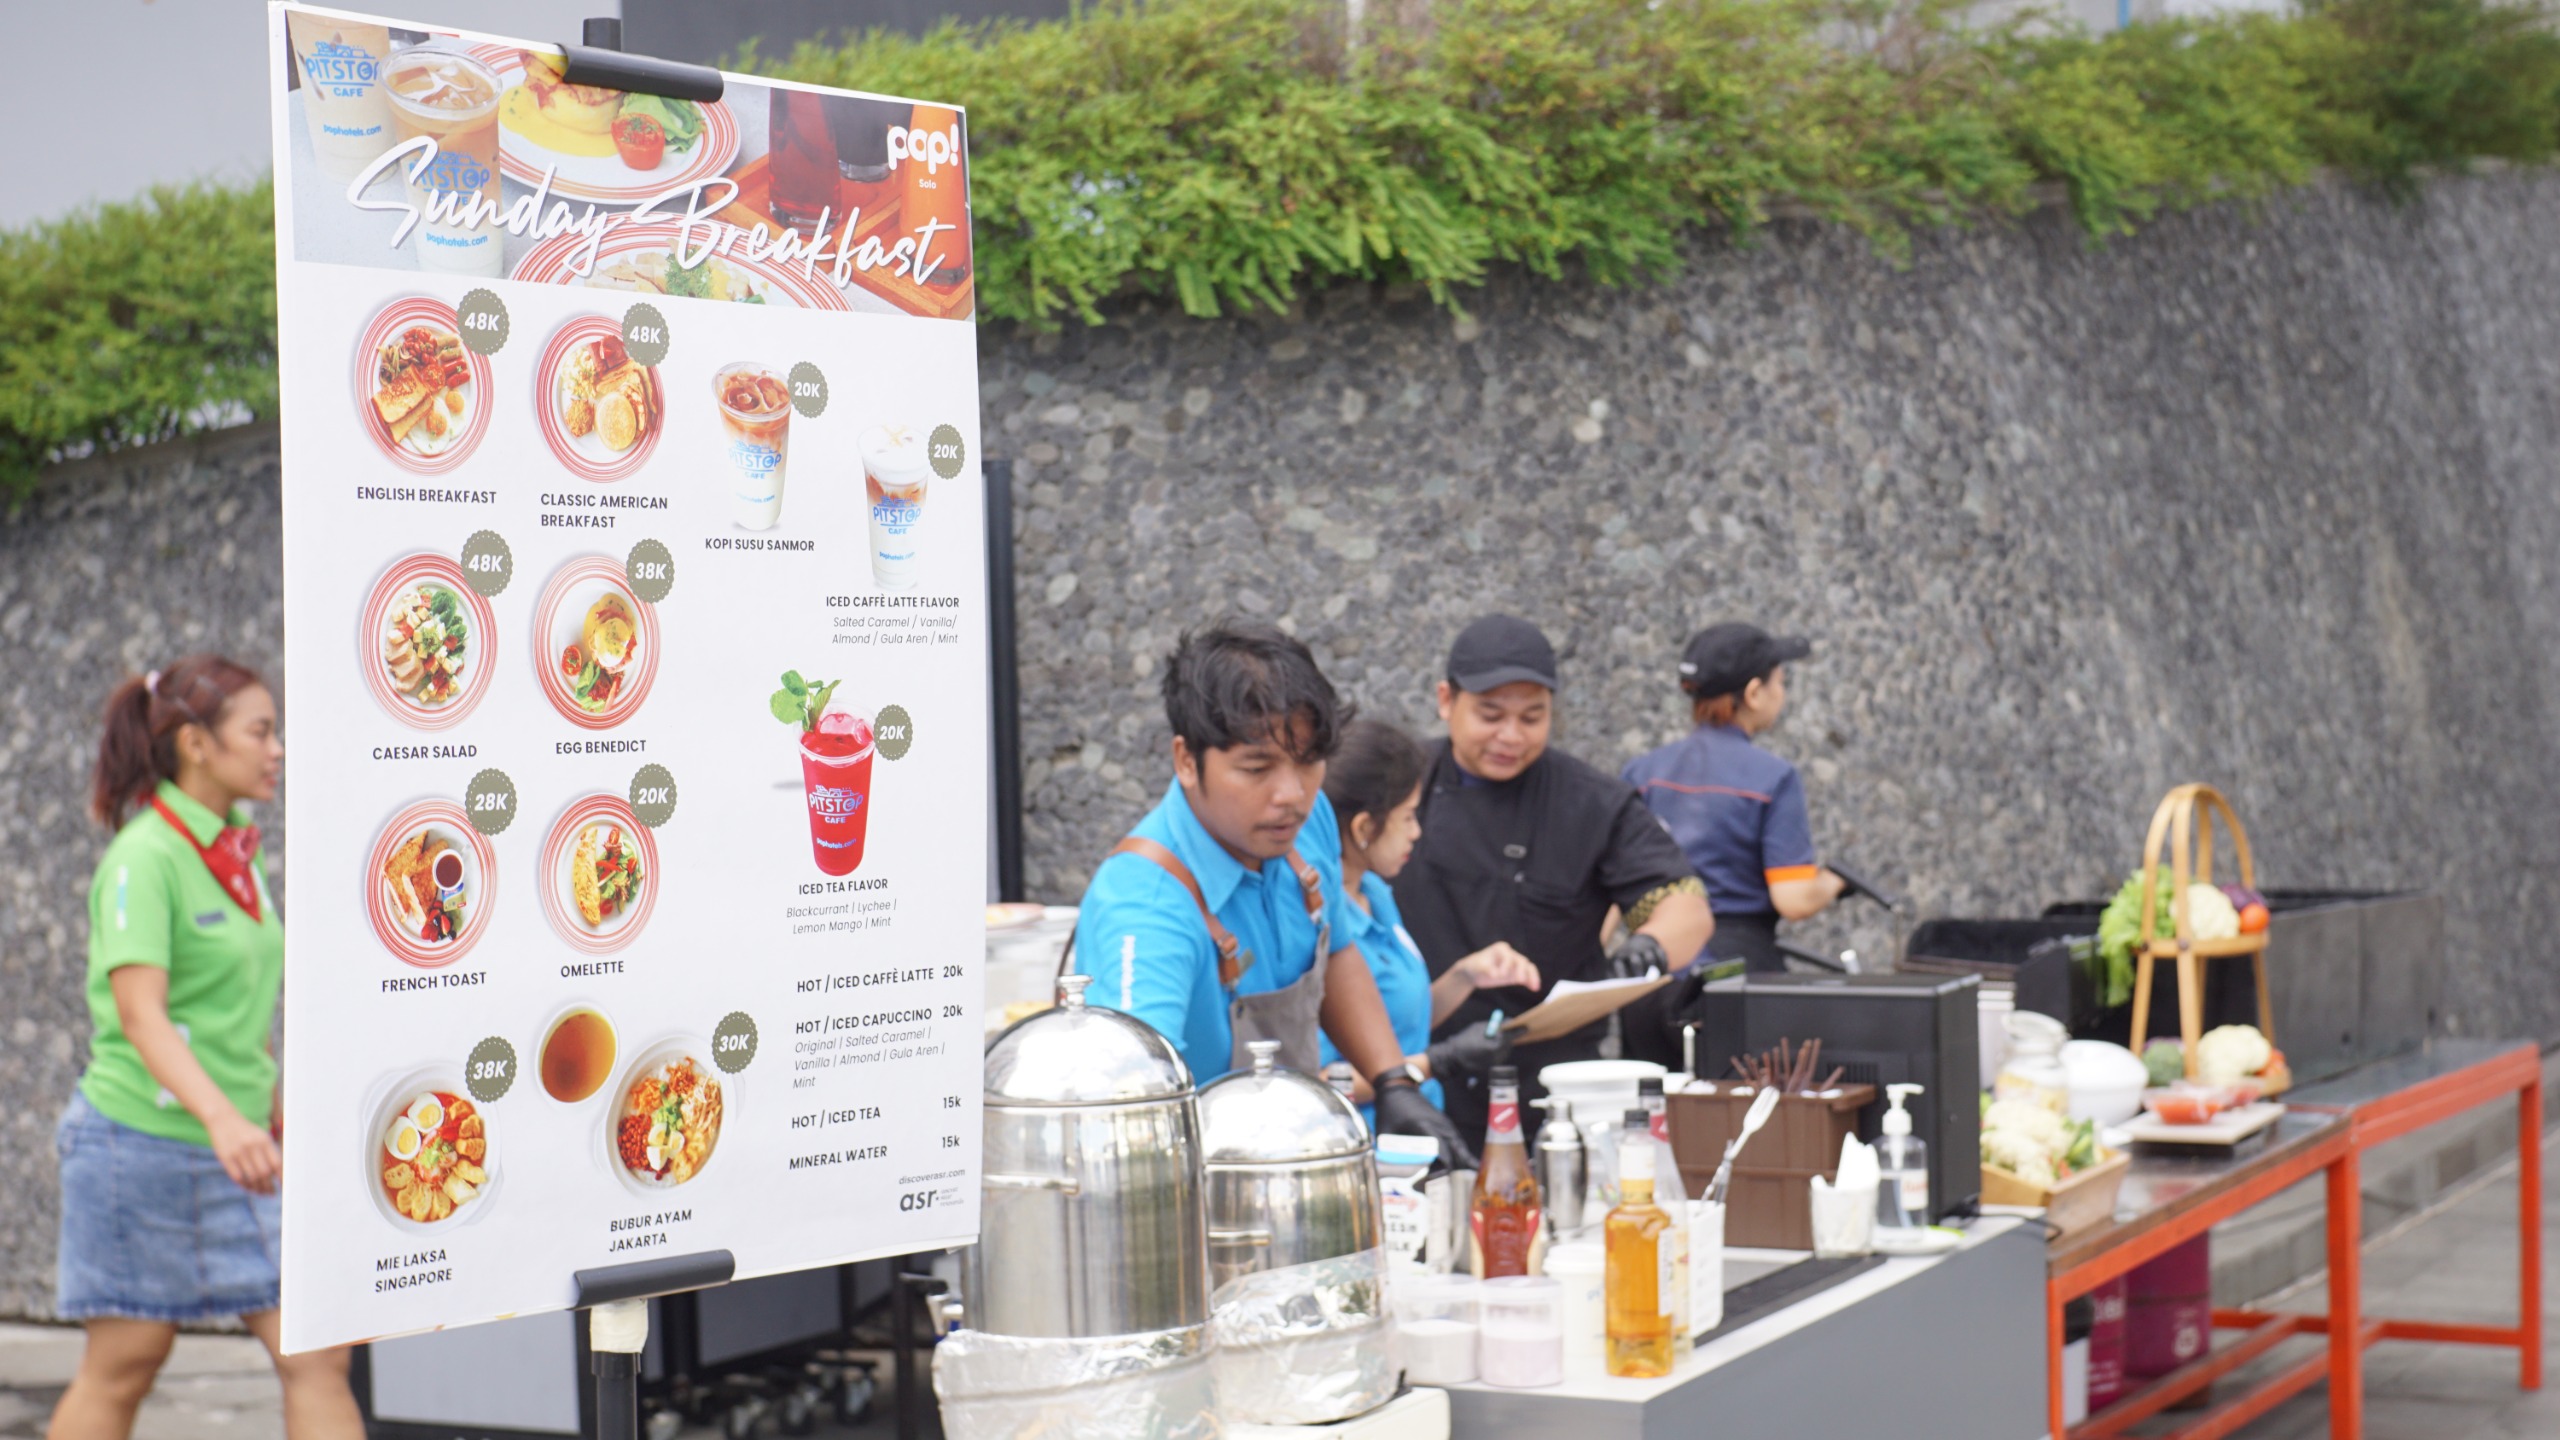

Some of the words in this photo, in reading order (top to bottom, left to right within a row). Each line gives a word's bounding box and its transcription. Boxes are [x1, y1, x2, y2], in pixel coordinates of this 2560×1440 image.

[333, 87, 363, 97] CAFE
[323, 124, 382, 136] pophotels.com
[919, 179, 936, 189] Solo
[347, 135, 628, 278] Sunday
[631, 175, 957, 289] Breakfast
[426, 232, 488, 247] pophotels.com
[465, 312, 499, 332] 48K
[630, 326, 661, 344] 48K
[794, 382, 820, 398] 20K
[934, 444, 958, 459] 20K
[357, 486, 416, 502] ENGLISH
[419, 489, 497, 504] BREAKFAST
[540, 494, 596, 508] CLASSIC
[600, 496, 668, 509] AMERICAN
[540, 514, 615, 528] BREAKFAST
[873, 506, 921, 523] PITSTOP
[705, 538, 732, 550] KOPI
[735, 538, 764, 551] SUSU
[767, 540, 815, 552] SANMOR
[468, 555, 503, 573] 48K
[635, 562, 667, 580] 38K
[826, 596, 850, 607] ICED
[853, 594, 885, 607] CAFFÈ
[888, 597, 918, 607] LATTE
[920, 597, 960, 608] FLAVOR
[834, 617, 865, 628] Salted
[868, 617, 910, 628] Caramel
[832, 634, 871, 644] Almond
[881, 634, 903, 644] Gula
[906, 634, 928, 644] Aren
[938, 634, 958, 644] Mint
[880, 725, 906, 740] 20K
[373, 746, 429, 760] CAESAR
[433, 744, 477, 758] SALAD
[556, 742, 582, 754] EGG
[586, 739, 646, 753] BENEDICT
[474, 793, 509, 811] 28K
[638, 787, 669, 804] 20K
[809, 793, 864, 812] PITSTOP
[825, 816, 846, 824] CAFE
[799, 883, 824, 895] ICED
[826, 882, 845, 893] TEA
[848, 879, 888, 892] FLAVOR
[786, 903, 849, 918] Blackcurrant
[858, 900, 891, 915] Lychee
[793, 923, 826, 934] Lemon
[829, 920, 862, 933] Mango
[871, 916, 891, 927] Mint
[560, 960, 624, 978] OMELETTE
[382, 976, 438, 993] FRENCH
[442, 972, 487, 988] TOAST
[797, 979, 822, 993] HOT
[833, 976, 860, 989] ICED
[863, 968, 898, 986] CAFFÈ
[901, 968, 934, 982] LATTE
[943, 965, 963, 978] 20k
[796, 1020, 821, 1035] HOT
[832, 1016, 859, 1030] ICED
[862, 1008, 932, 1027] CAPUCCINO
[943, 1004, 963, 1018] 20k
[718, 1035, 749, 1053] 30K
[795, 1038, 837, 1055] Original
[846, 1033, 879, 1048] Salted
[882, 1028, 925, 1043] Caramel
[795, 1057, 830, 1071] Vanilla
[839, 1051, 881, 1066] Almond
[889, 1047, 913, 1060] Gula
[916, 1045, 939, 1057] Aren
[473, 1060, 506, 1081] 38K
[792, 1076, 816, 1089] Mint
[792, 1115, 817, 1129] HOT
[828, 1110, 856, 1124] ICED
[860, 1107, 881, 1120] TEA
[943, 1096, 961, 1109] 15k
[789, 1152, 842, 1170] MINERAL
[846, 1145, 888, 1162] WATER
[942, 1135, 960, 1148] 15k
[899, 1168, 966, 1185] discoverasr.com
[610, 1215, 652, 1233] BUBUR
[655, 1209, 693, 1225] AYAM
[609, 1233, 668, 1253] JAKARTA
[376, 1257, 402, 1273] MIE
[404, 1248, 448, 1268] LAKSA
[375, 1268, 453, 1293] SINGAPORE
